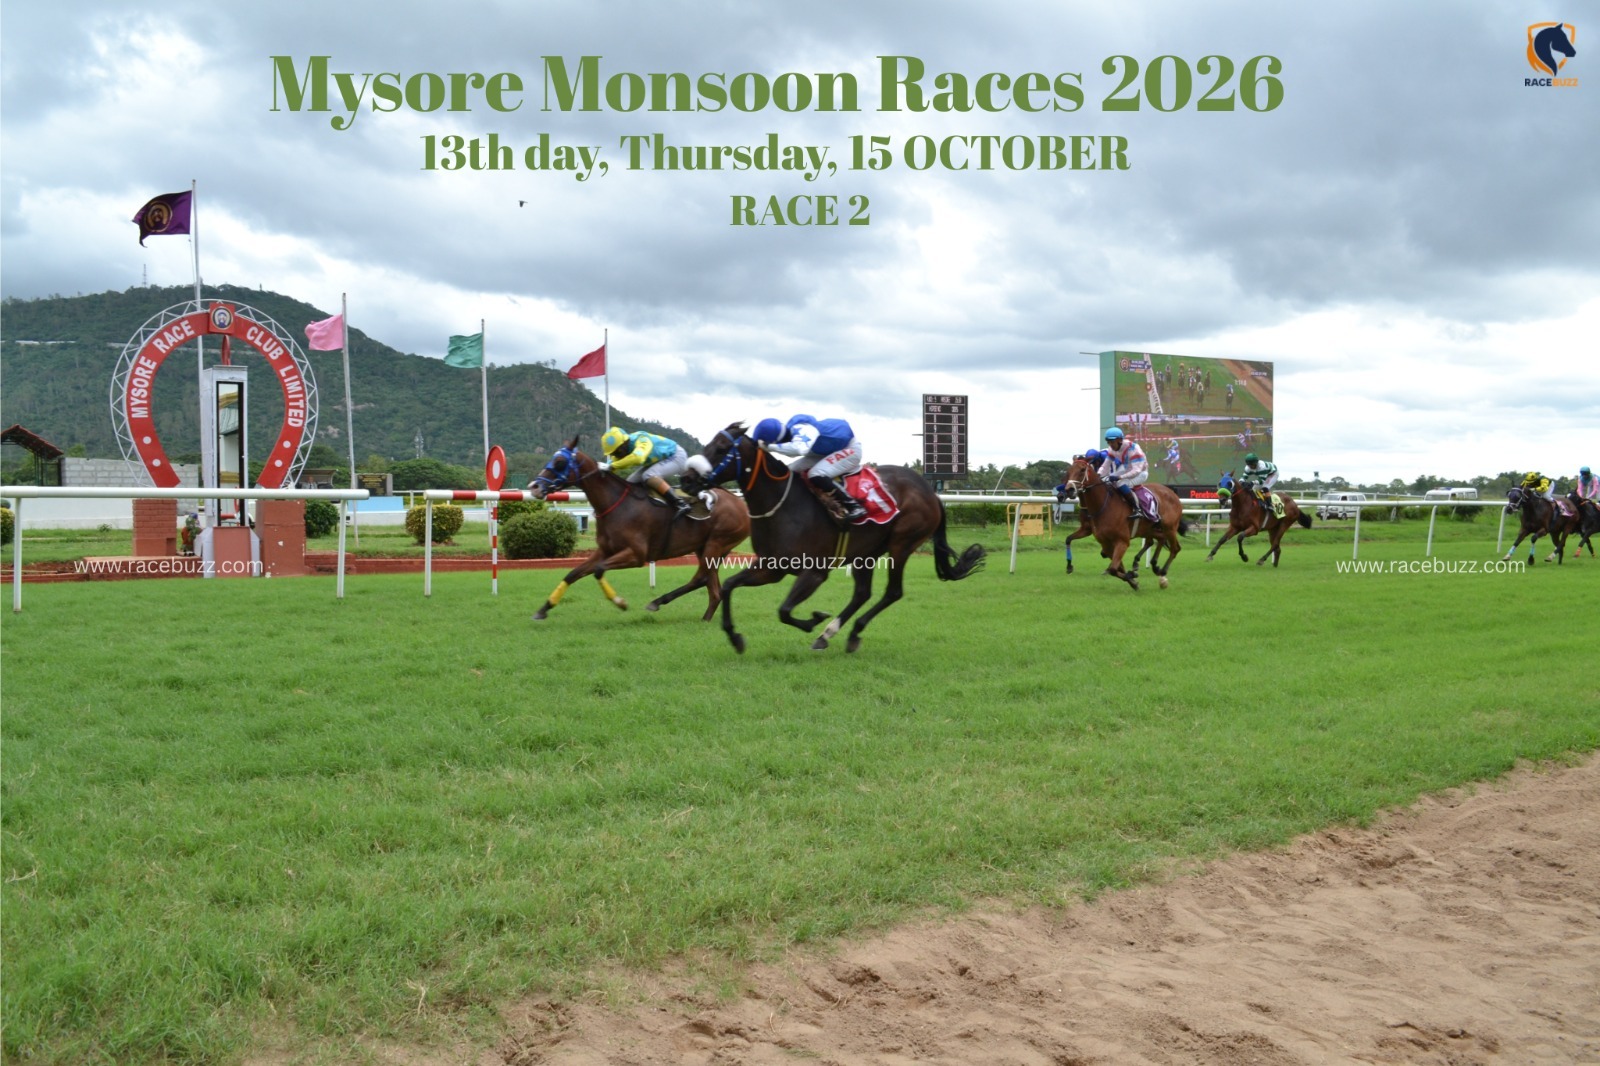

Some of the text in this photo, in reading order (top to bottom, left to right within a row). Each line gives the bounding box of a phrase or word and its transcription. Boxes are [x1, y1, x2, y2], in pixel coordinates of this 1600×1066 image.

[130, 319, 304, 428] MYSORE RACE CLUB LIMITED
